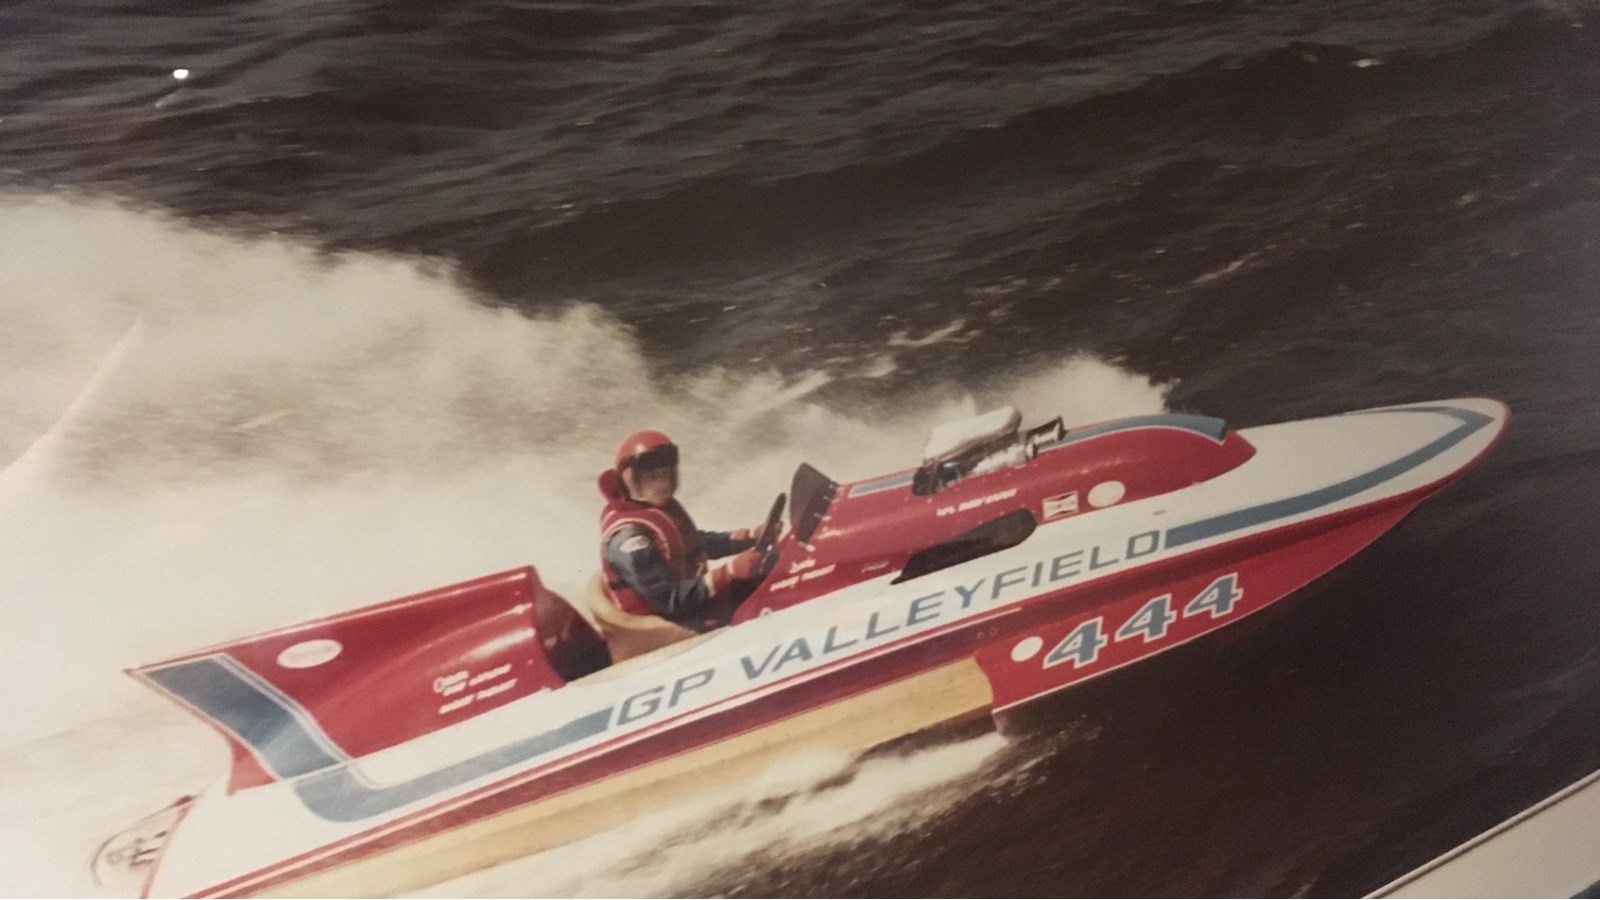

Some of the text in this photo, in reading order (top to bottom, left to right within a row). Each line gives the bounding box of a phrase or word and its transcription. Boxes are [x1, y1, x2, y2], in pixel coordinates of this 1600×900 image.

[617, 530, 1161, 726] GP VALLEYFIELD
[1042, 572, 1244, 669] 444
